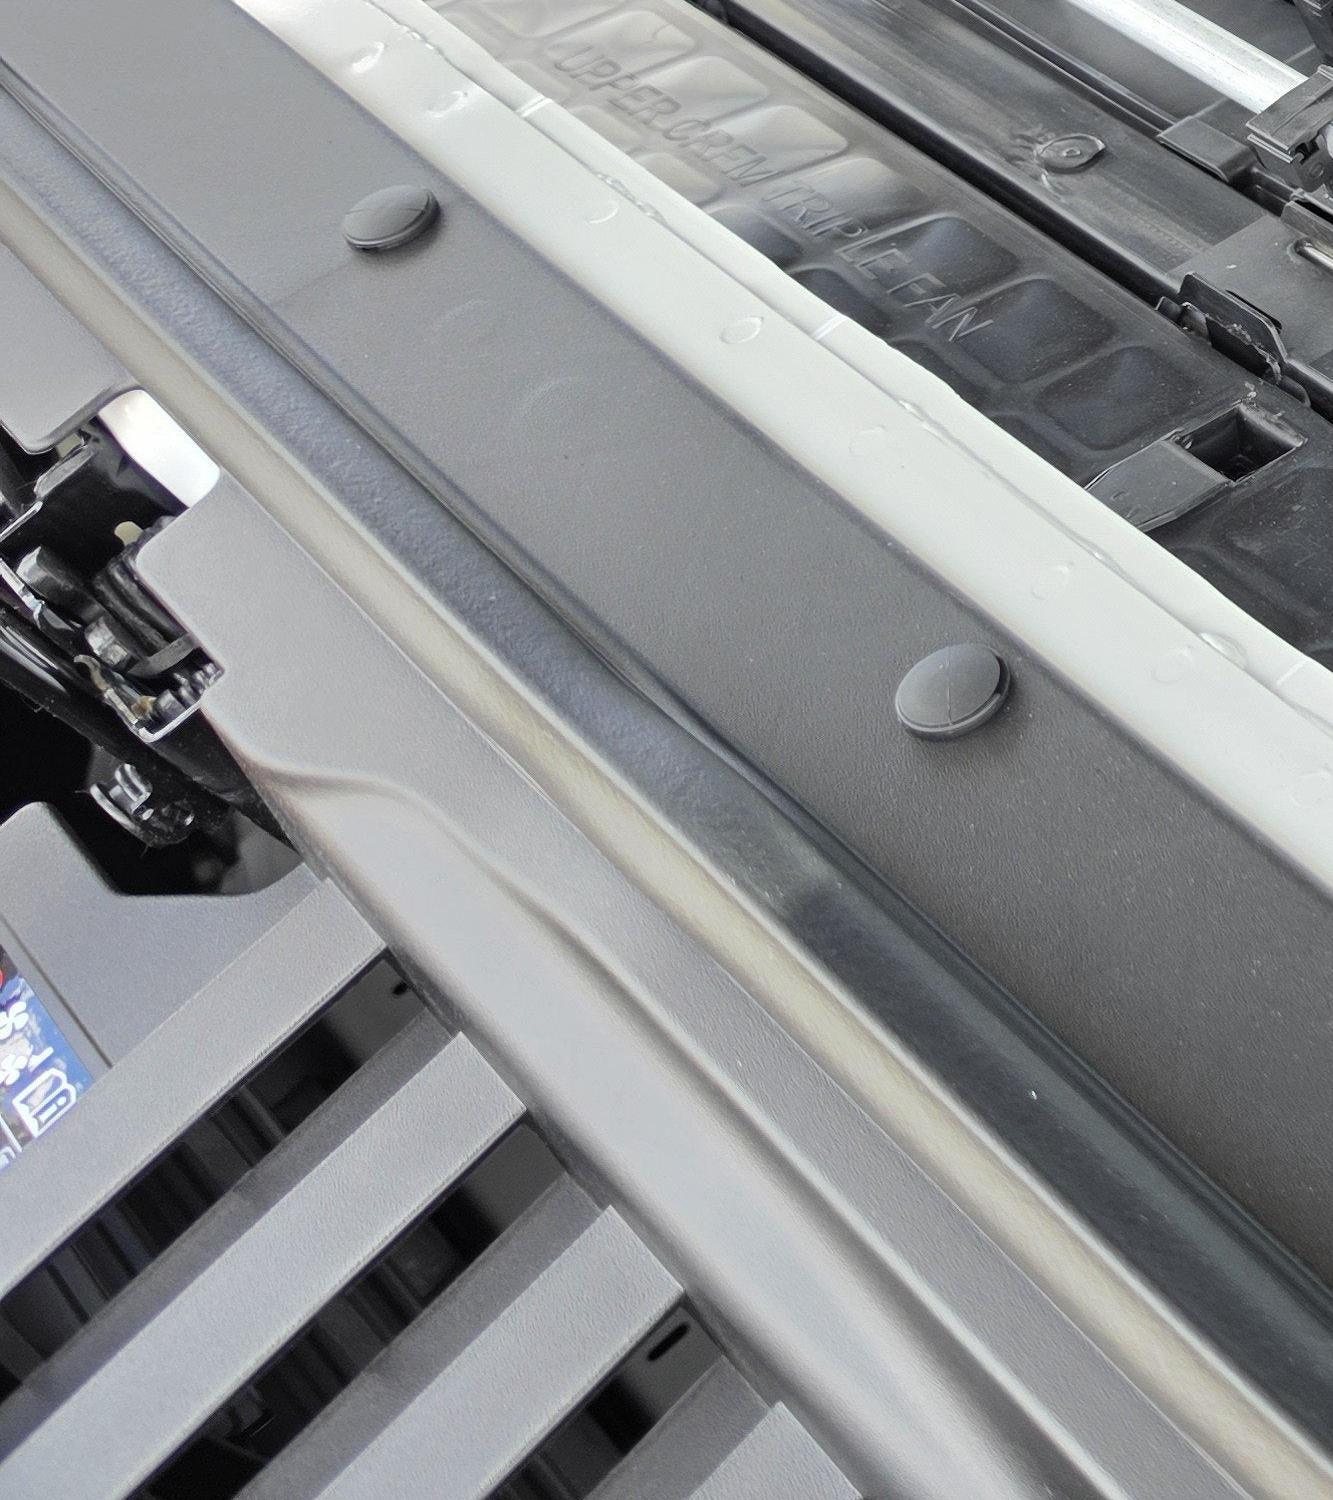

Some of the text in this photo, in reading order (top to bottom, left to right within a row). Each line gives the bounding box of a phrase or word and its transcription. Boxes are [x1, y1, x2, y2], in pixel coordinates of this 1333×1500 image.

[553, 45, 683, 125] UPPER
[760, 183, 913, 280] TRIPLE
[886, 272, 994, 342] FAN
